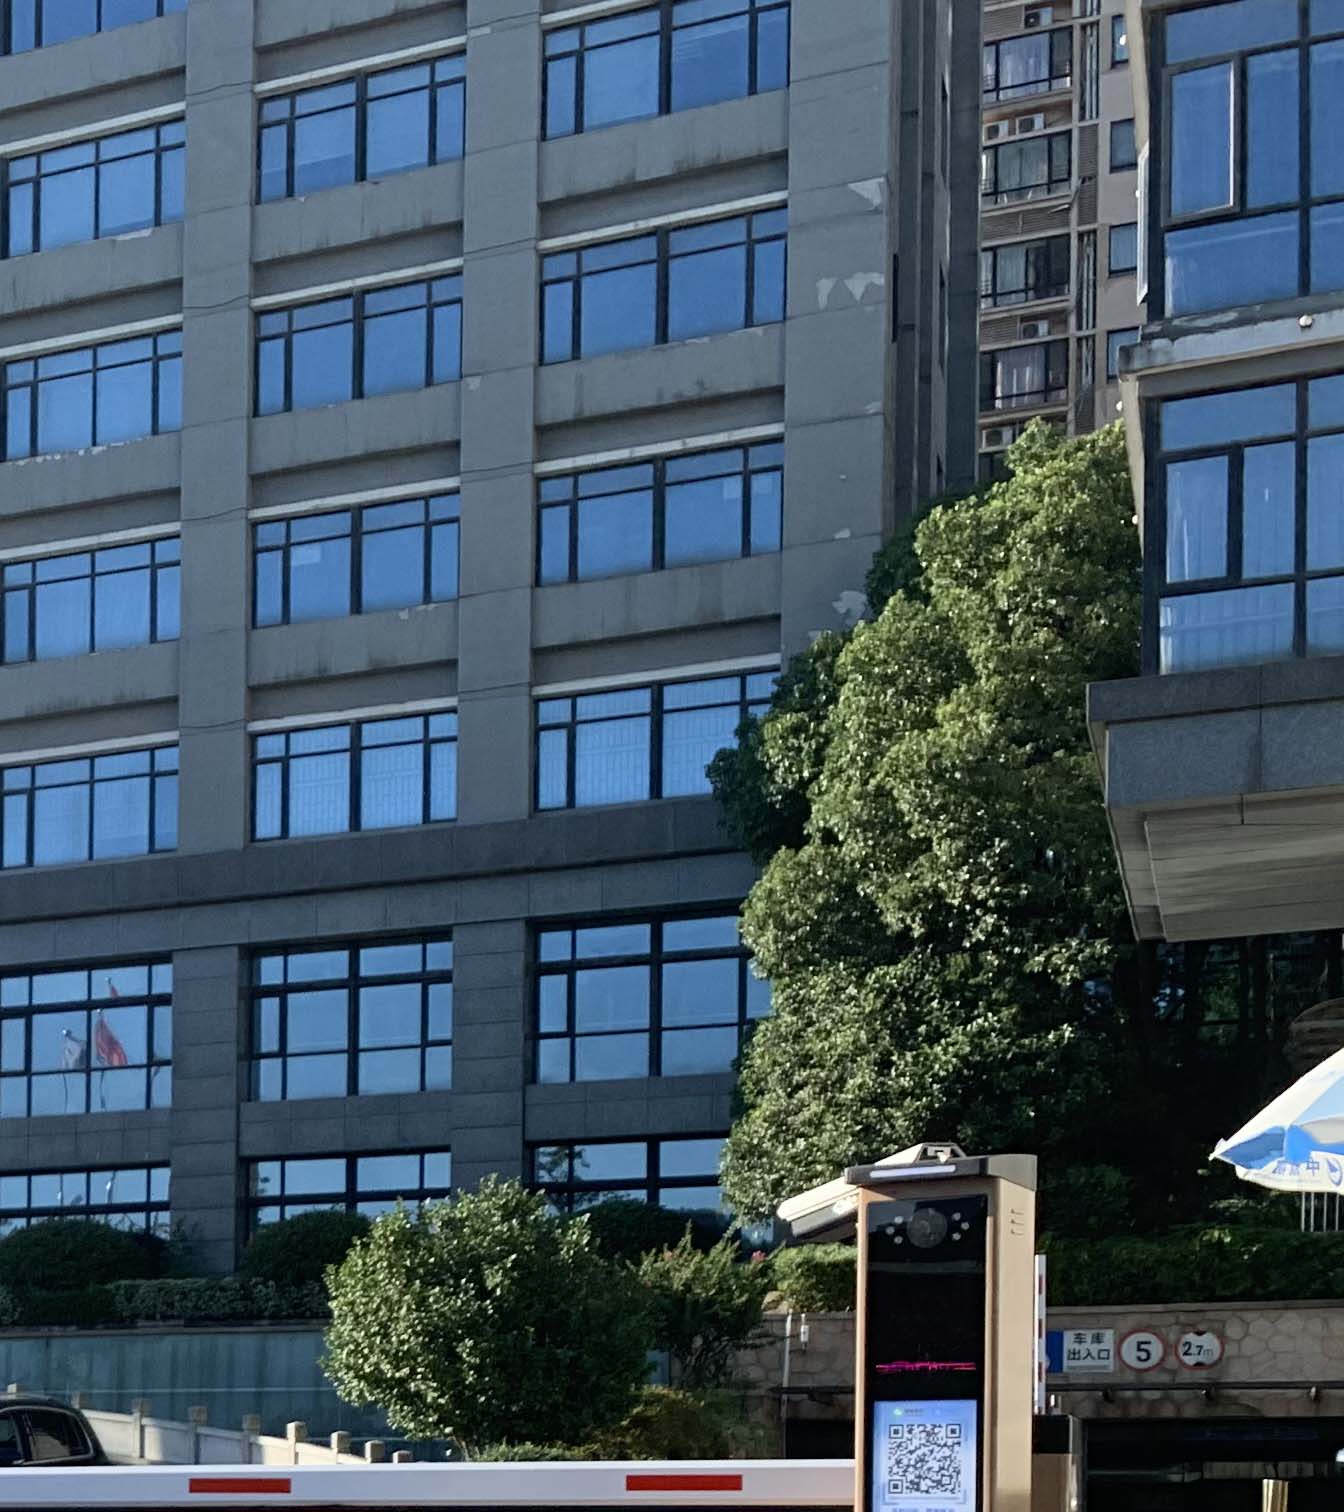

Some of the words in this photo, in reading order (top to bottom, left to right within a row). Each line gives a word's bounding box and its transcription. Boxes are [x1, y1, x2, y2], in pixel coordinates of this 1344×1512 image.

[1073, 1332, 1105, 1345] 车库
[1067, 1347, 1110, 1361] 出入口
[1135, 1340, 1152, 1362] 5
